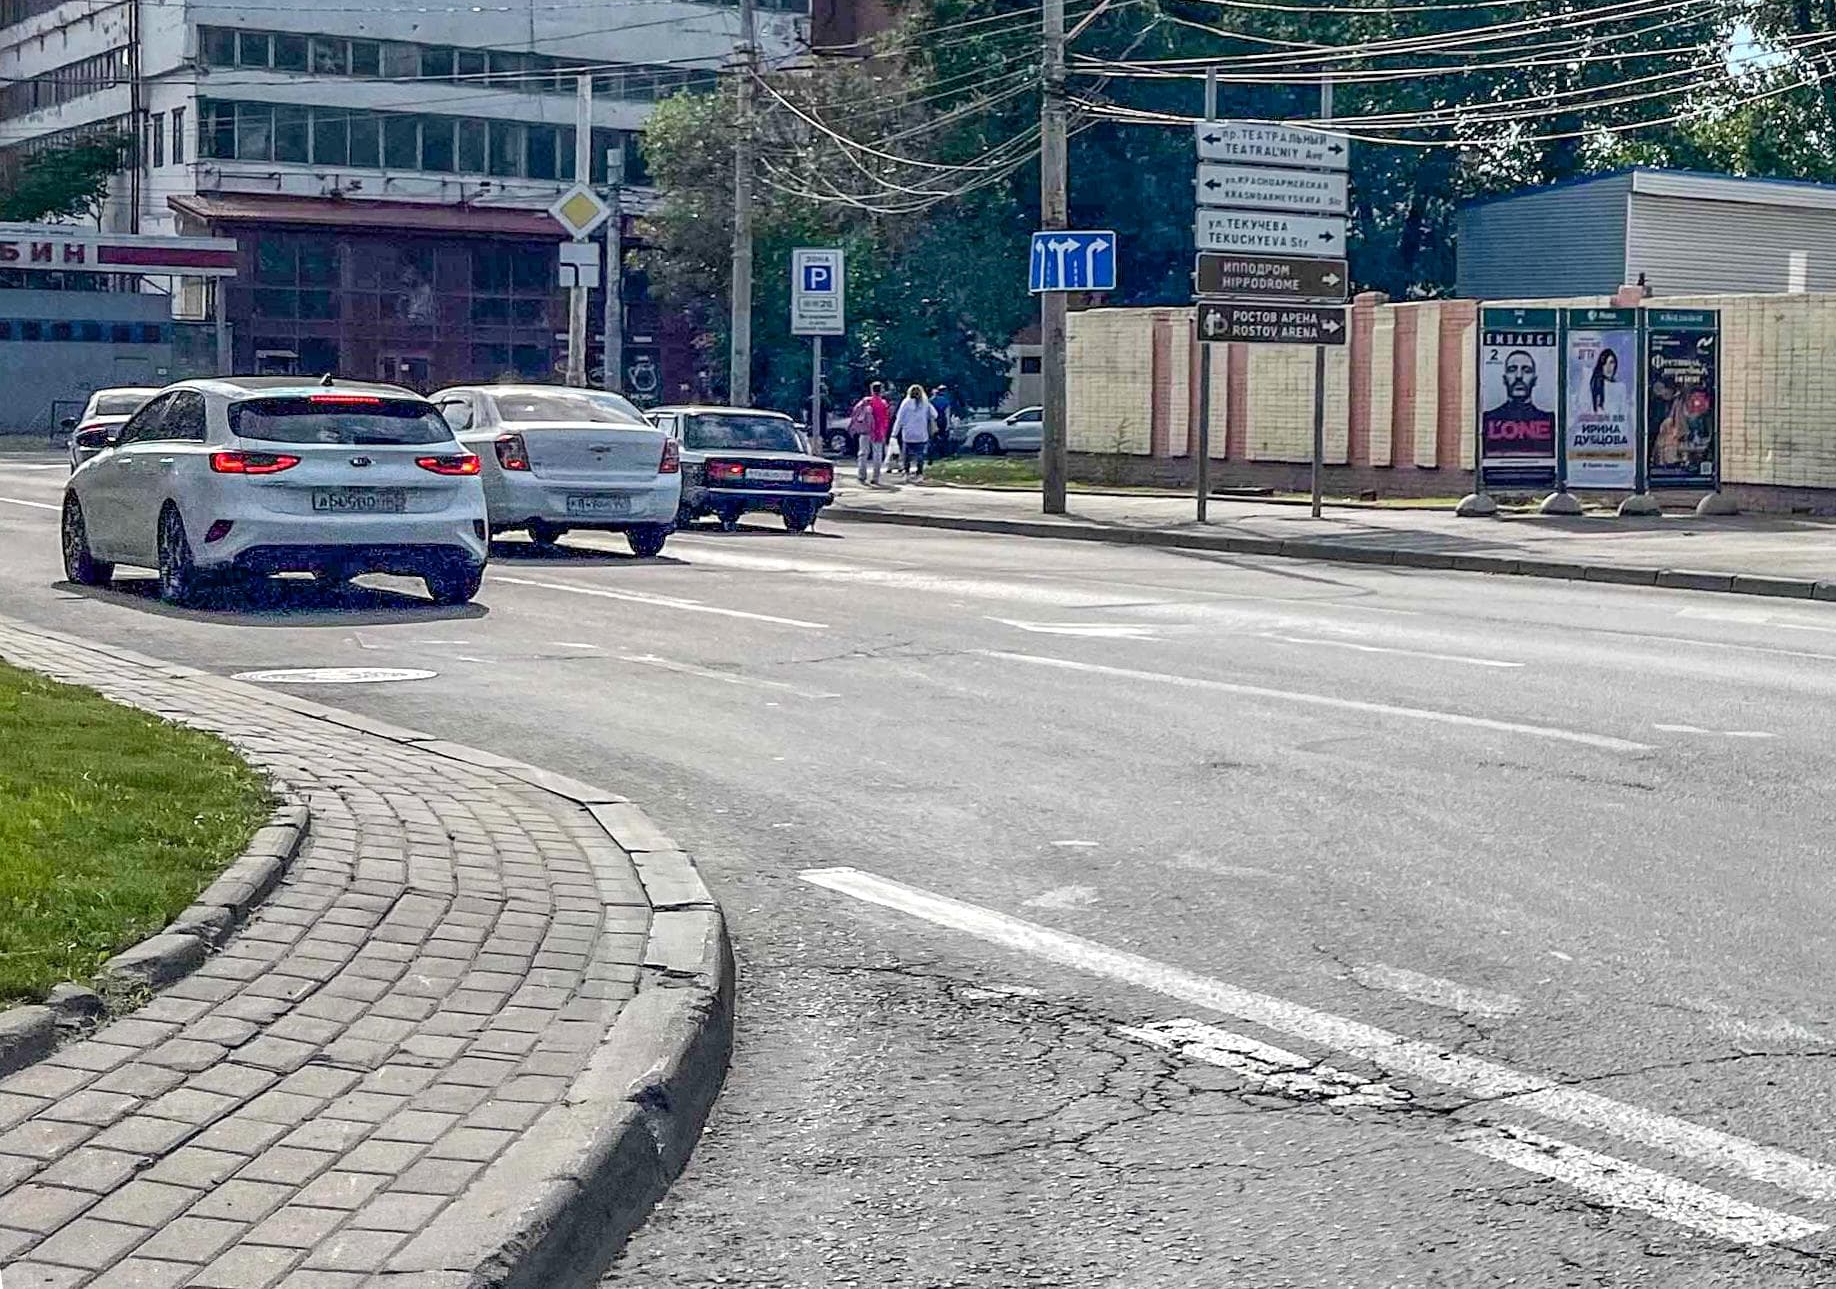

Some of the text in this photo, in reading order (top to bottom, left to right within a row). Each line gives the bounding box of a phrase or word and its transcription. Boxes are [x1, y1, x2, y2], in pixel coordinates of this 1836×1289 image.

[1208, 232, 1309, 249] TEKUCHYEVA Str
[1223, 261, 1291, 276] ИППОДРОМ
[1222, 276, 1301, 291] HIPPODROME
[1232, 311, 1319, 324] РОСТОВ АРЕНА
[1231, 325, 1319, 339] ROSTOV ARENA
[1490, 348, 1499, 361] 2
